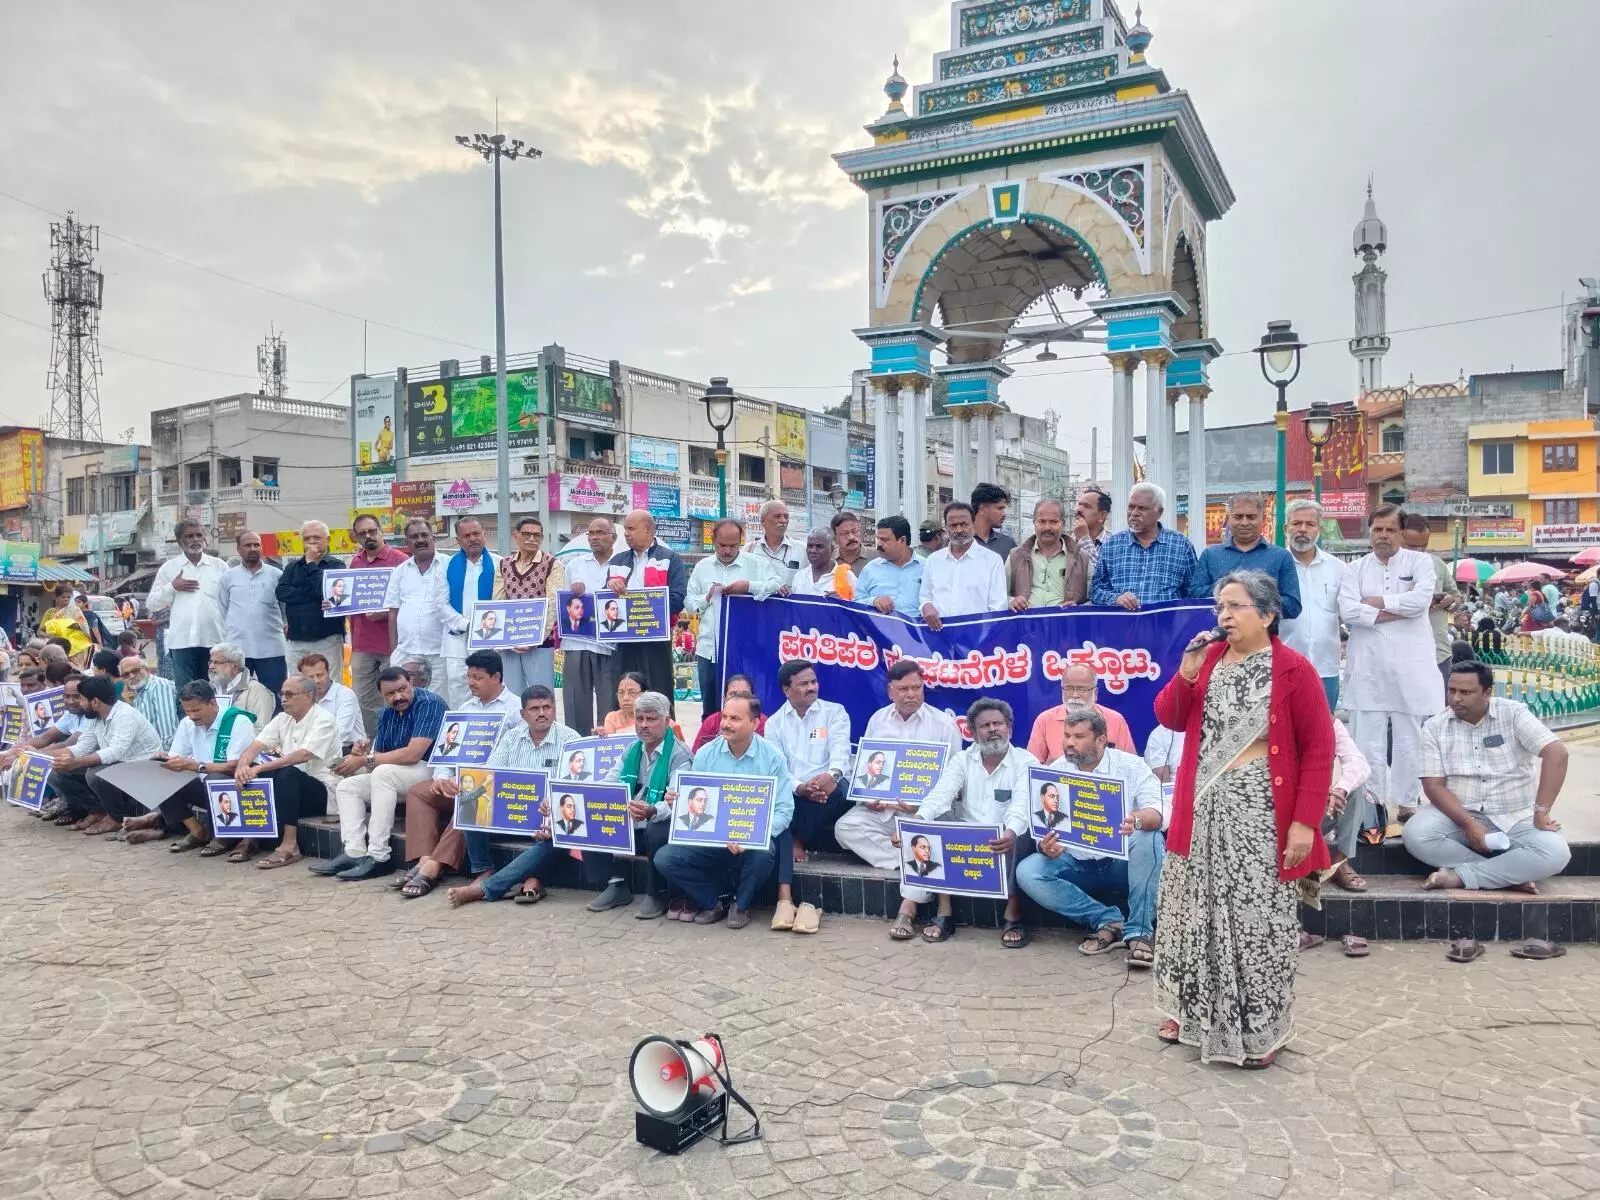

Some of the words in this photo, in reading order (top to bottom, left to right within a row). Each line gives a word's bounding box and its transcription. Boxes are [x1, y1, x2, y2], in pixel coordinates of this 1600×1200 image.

[442, 490, 480, 500] Mahalakshmi
[570, 487, 606, 498] Mahalakshmi
[394, 495, 422, 506] BHAVANI
[905, 748, 939, 758] ಸಂವಿಧಾನ
[724, 794, 743, 803] ಗೌರವ
[945, 842, 972, 851] ಸಂವಿಧಾನ
